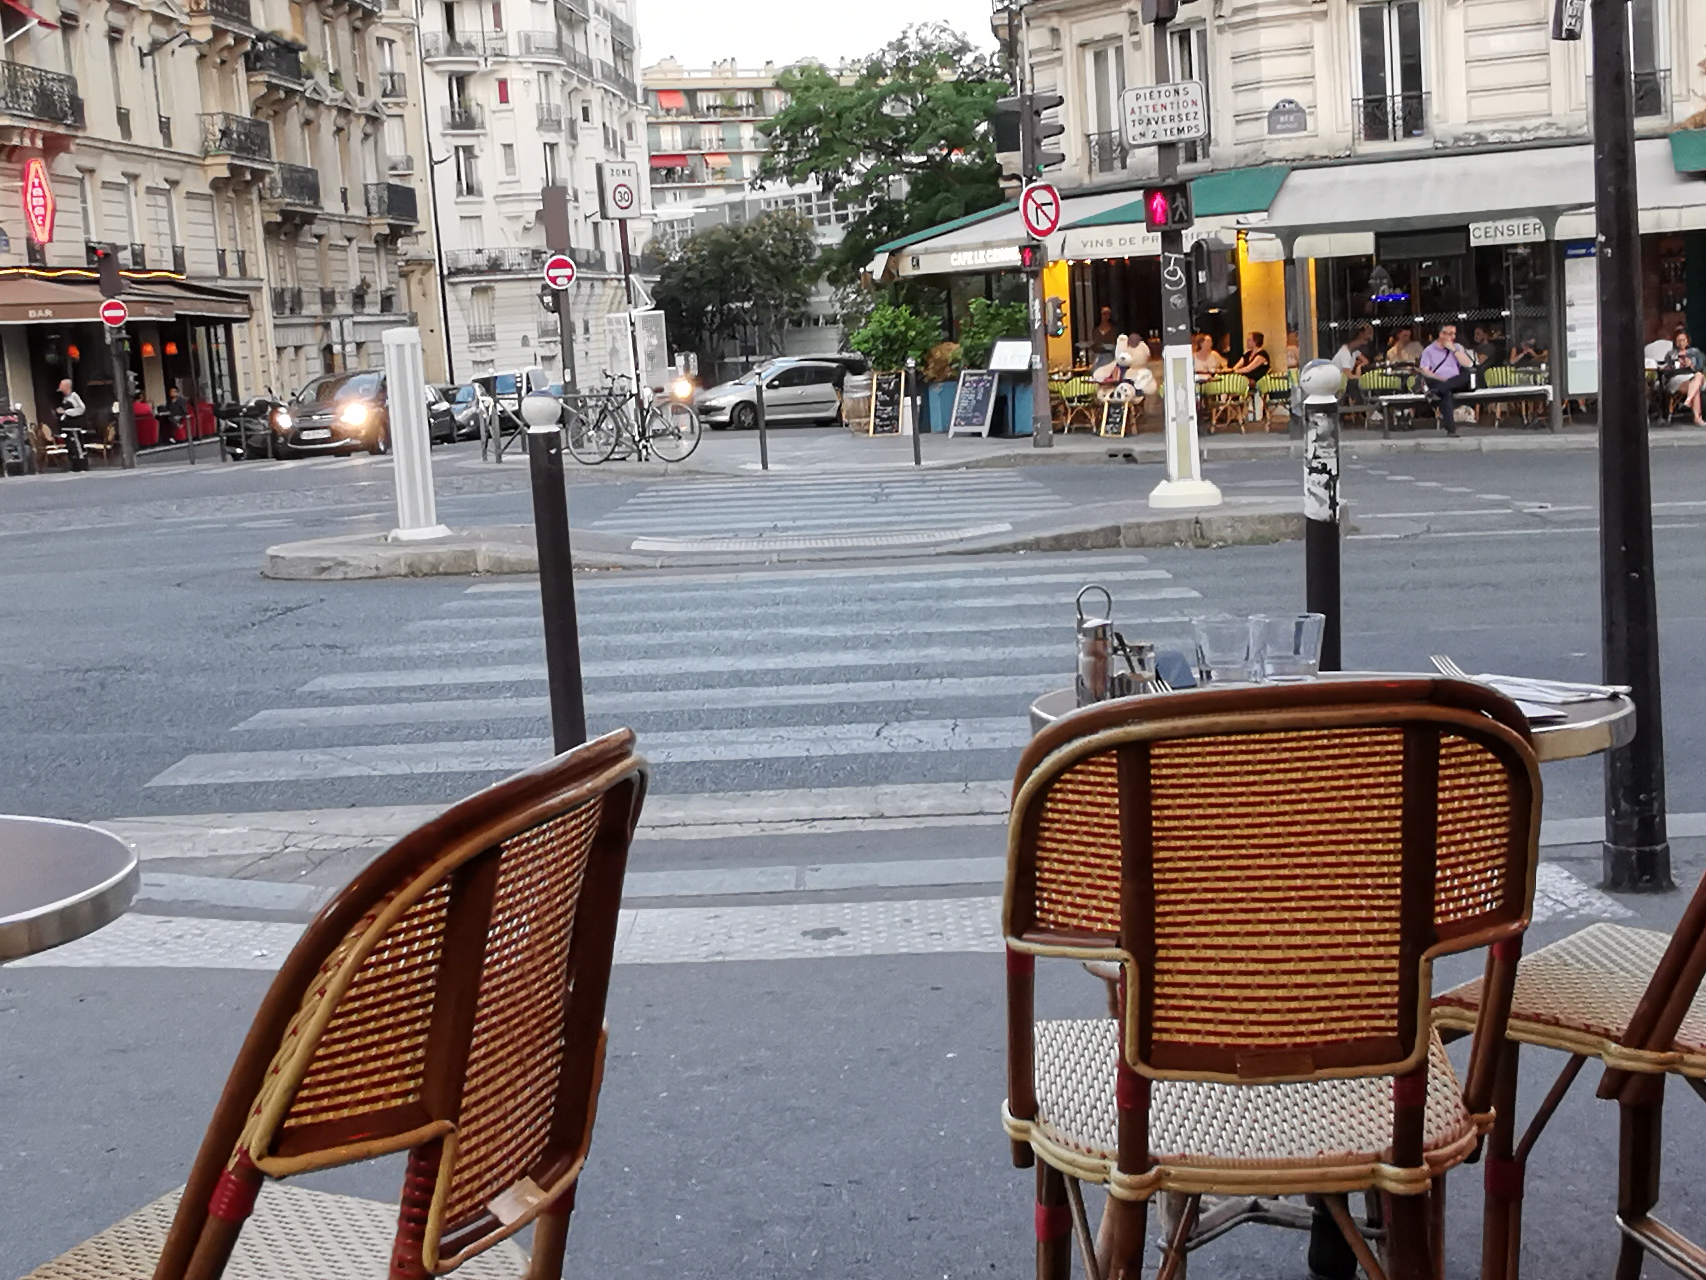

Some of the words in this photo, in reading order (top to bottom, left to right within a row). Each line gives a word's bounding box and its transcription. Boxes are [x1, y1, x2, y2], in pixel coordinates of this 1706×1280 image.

[1129, 98, 1199, 116] ATTENTION
[1151, 129, 1158, 140] 2
[1163, 123, 1200, 137] TEMPS
[610, 168, 633, 177] ZONE
[616, 190, 630, 203] 30
[1471, 223, 1544, 240] CENSIER
[1081, 237, 1114, 249] VINS
[1119, 235, 1136, 247] DE
[28, 308, 54, 319] BAR
